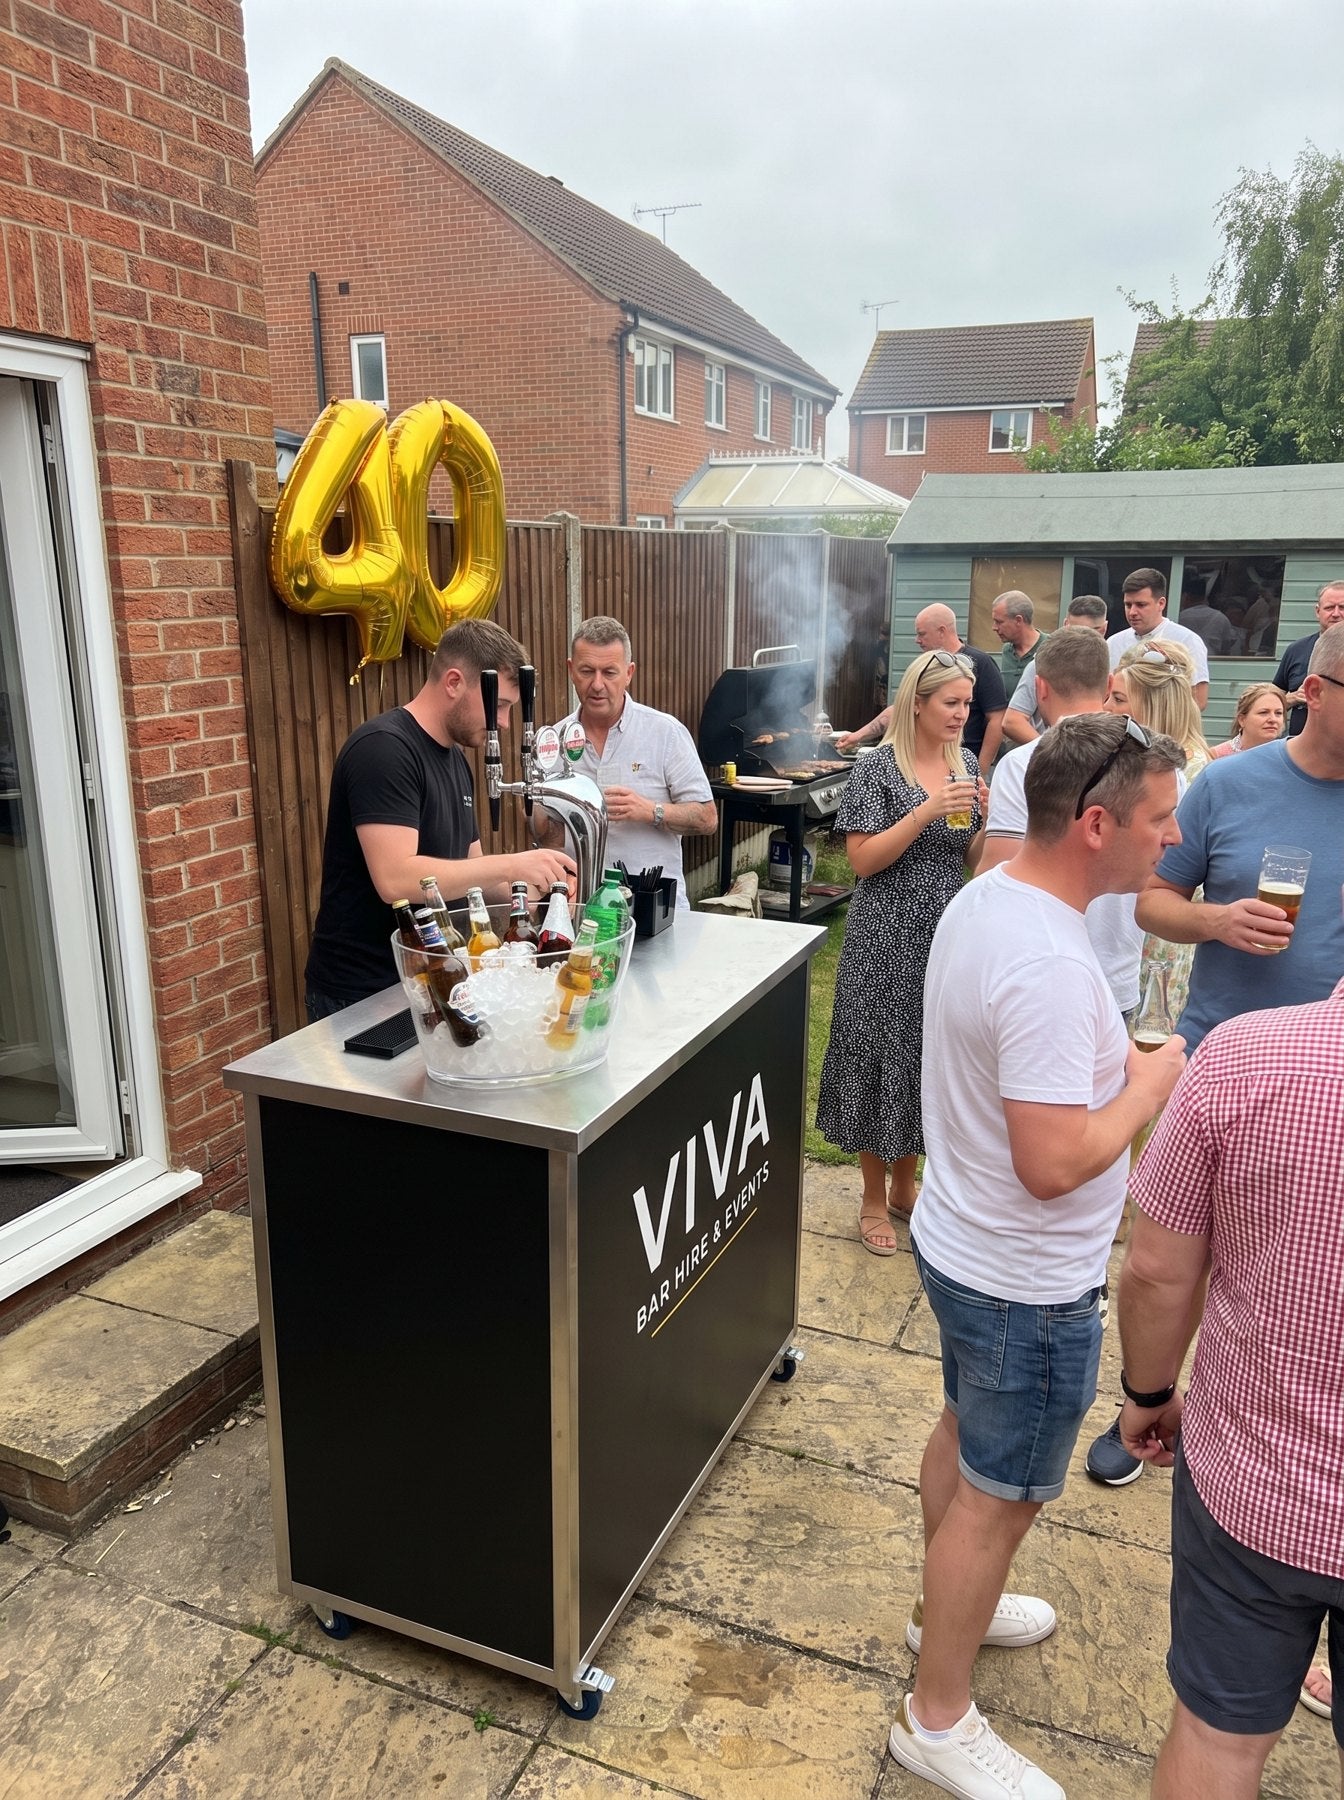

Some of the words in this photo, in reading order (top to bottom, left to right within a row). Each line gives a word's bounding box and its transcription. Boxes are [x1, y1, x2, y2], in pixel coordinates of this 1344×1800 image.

[269, 398, 506, 664] 40
[633, 1073, 770, 1274] VIVA
[637, 1280, 669, 1334] BAR
[675, 1233, 708, 1290] HIRE
[713, 1219, 721, 1243] &
[725, 1161, 770, 1230] EVENTS
